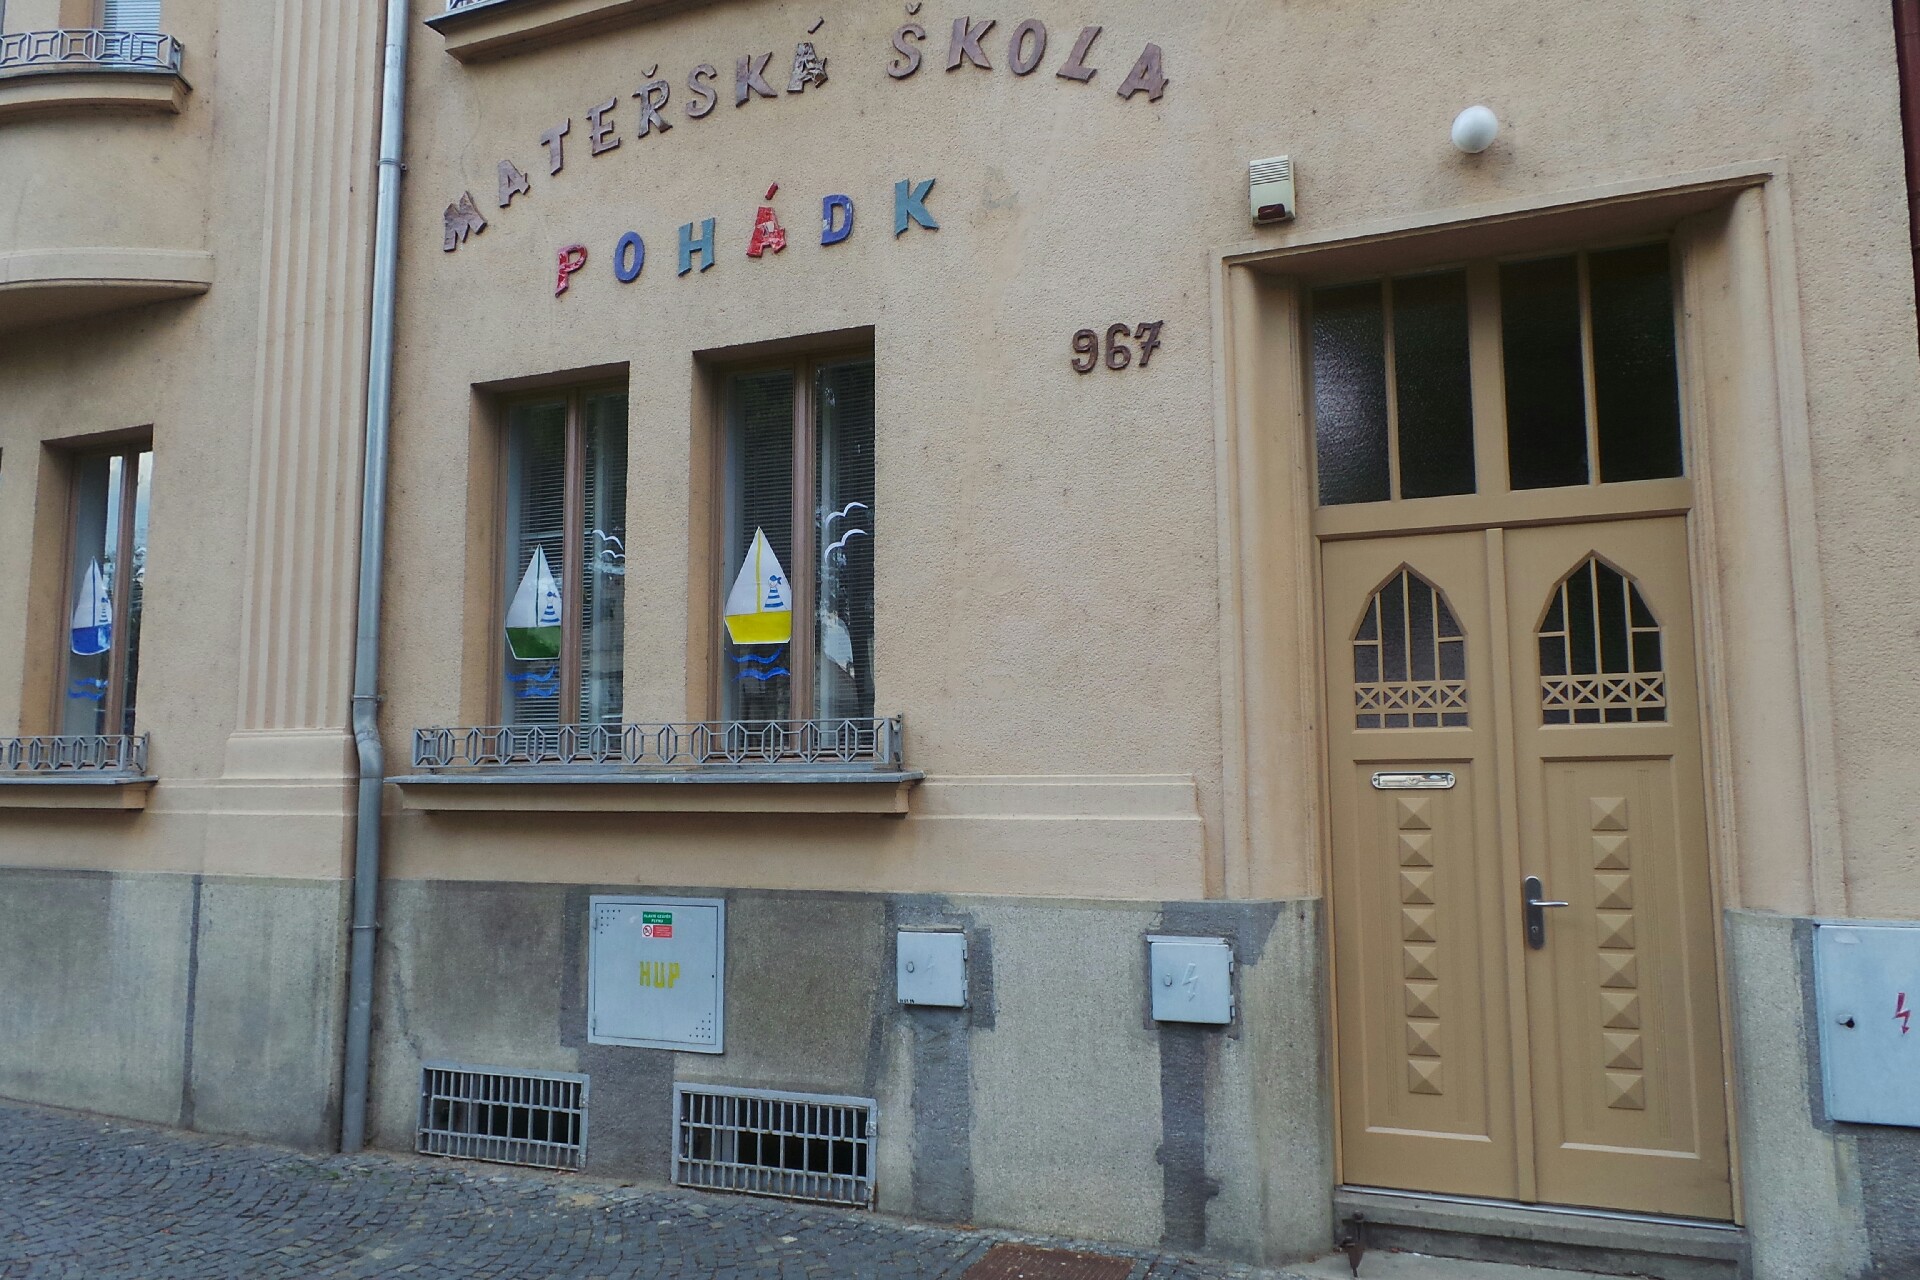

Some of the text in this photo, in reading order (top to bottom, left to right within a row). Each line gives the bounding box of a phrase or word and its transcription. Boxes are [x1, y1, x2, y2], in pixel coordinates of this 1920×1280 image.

[442, 1, 1170, 253] MATEŘSKÁ ŠKOLA
[554, 177, 940, 299] POHÁDK
[1071, 319, 1164, 375] 967
[639, 960, 681, 989] HUP
